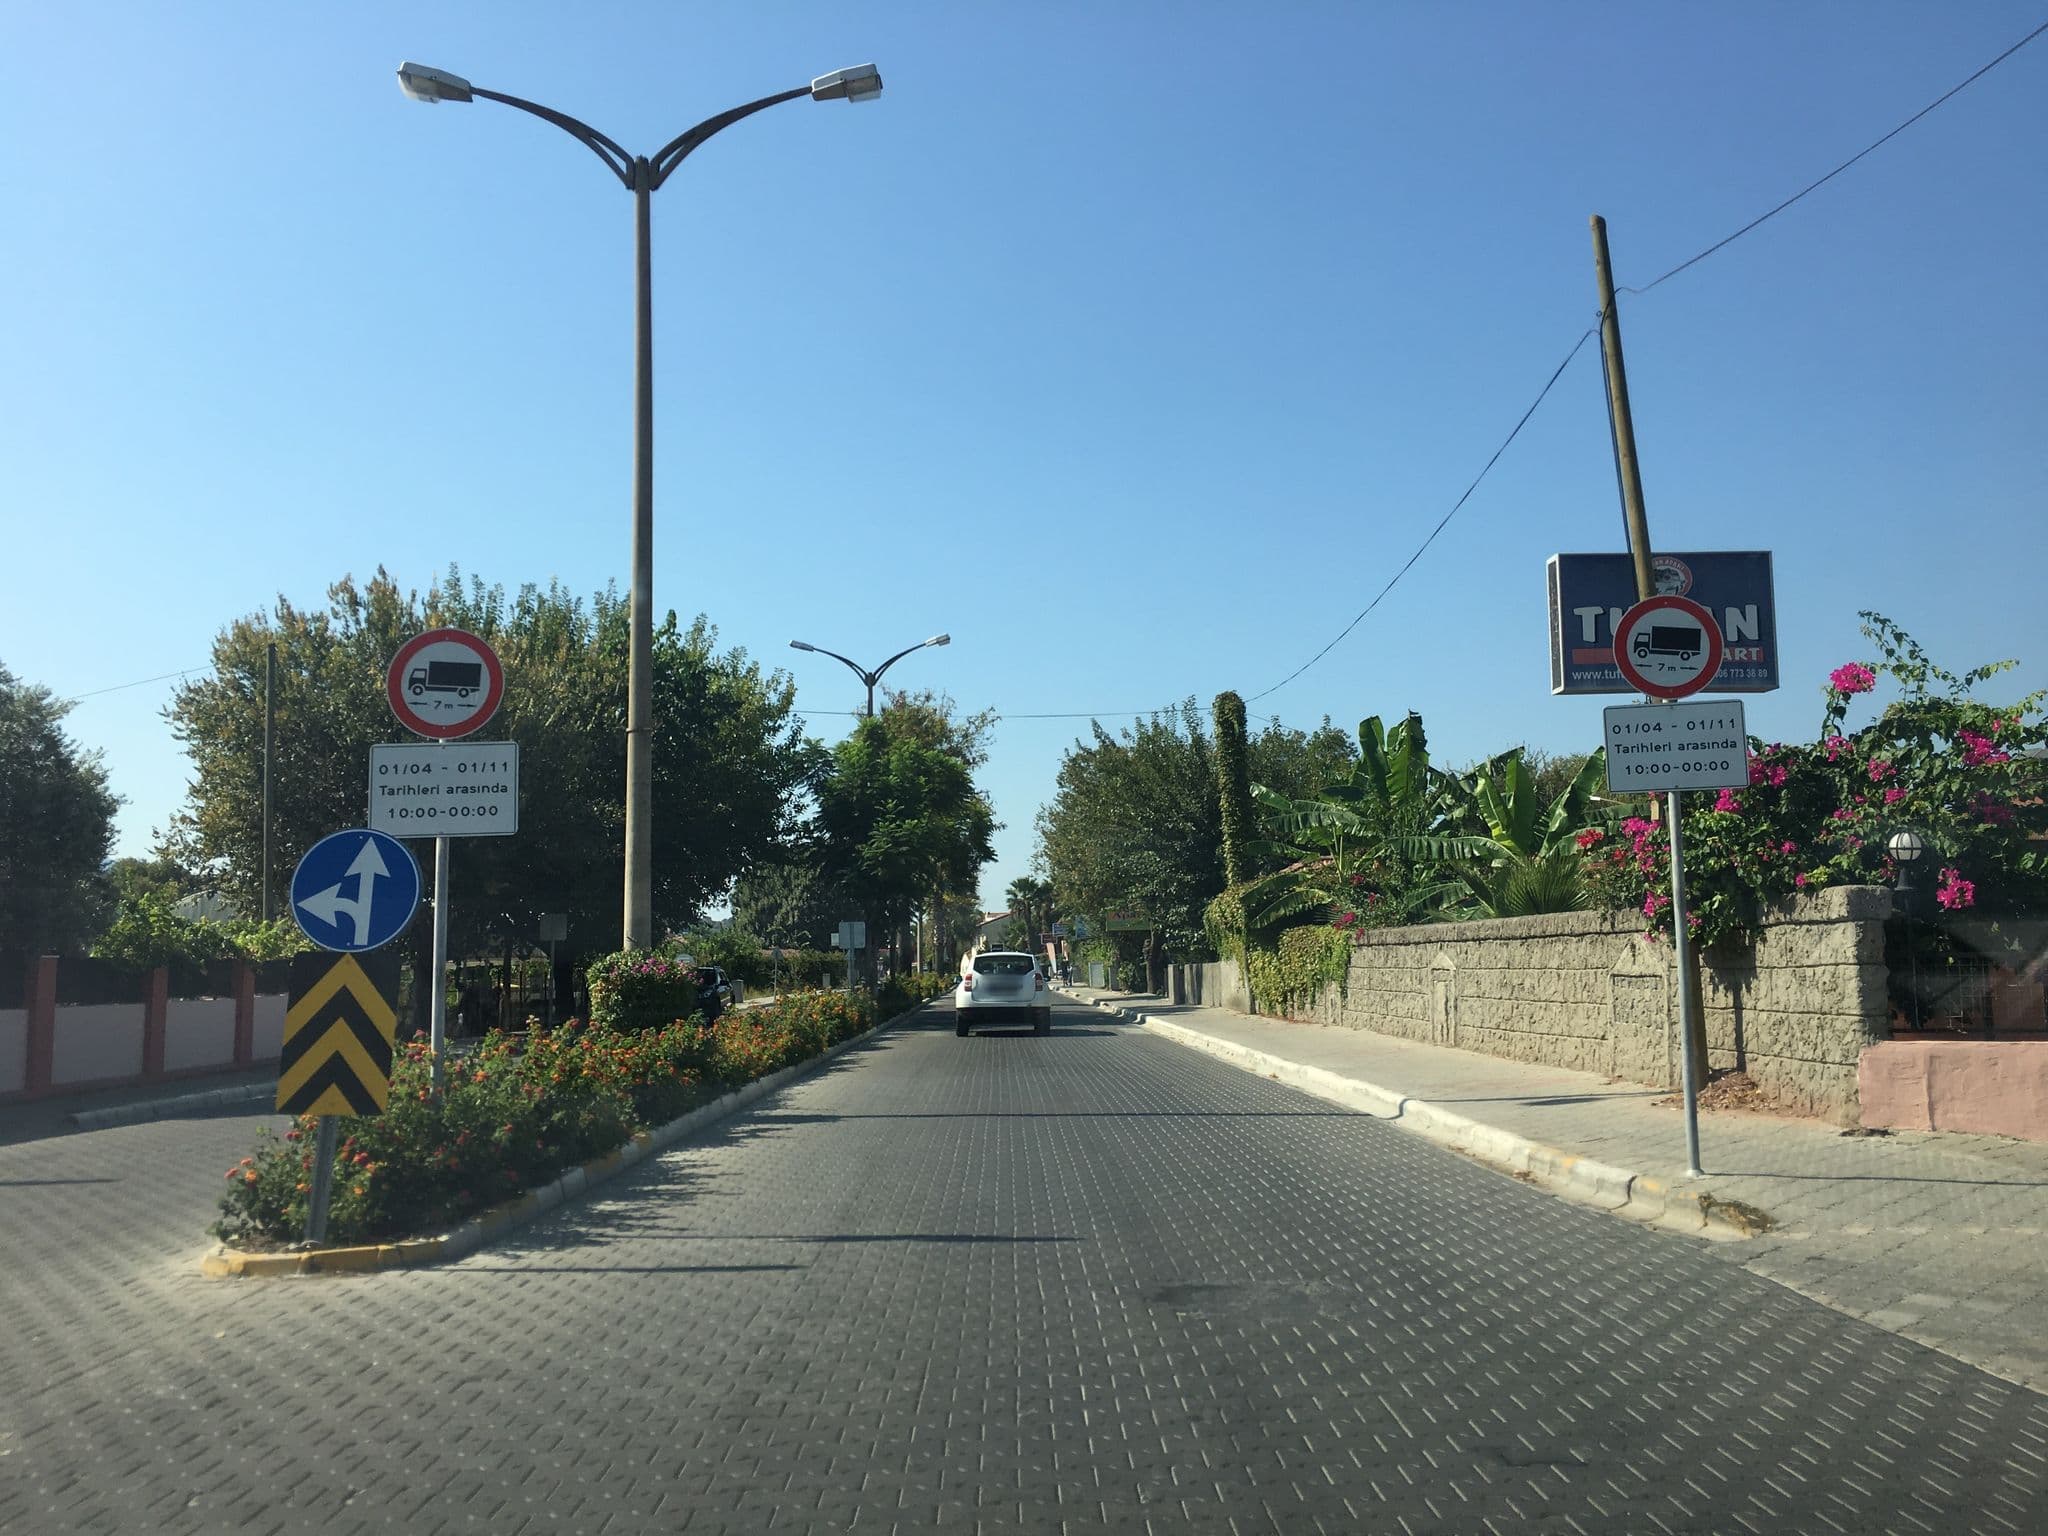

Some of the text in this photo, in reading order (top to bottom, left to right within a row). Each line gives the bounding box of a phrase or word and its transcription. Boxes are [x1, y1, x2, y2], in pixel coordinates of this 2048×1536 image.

[1723, 647, 1760, 661] ART
[1730, 669, 1744, 679] 773
[434, 701, 443, 709] 7
[1612, 722, 1663, 735] 01/04
[1686, 718, 1736, 731] 01/11
[1614, 738, 1737, 754] Tarihleri arasında
[379, 763, 432, 775] 01/04
[457, 762, 508, 774] 01/11
[1625, 760, 1730, 775] 10:00-00:00
[379, 783, 508, 796] Tarihleri arasında
[388, 805, 499, 819] 10:00-00:00
